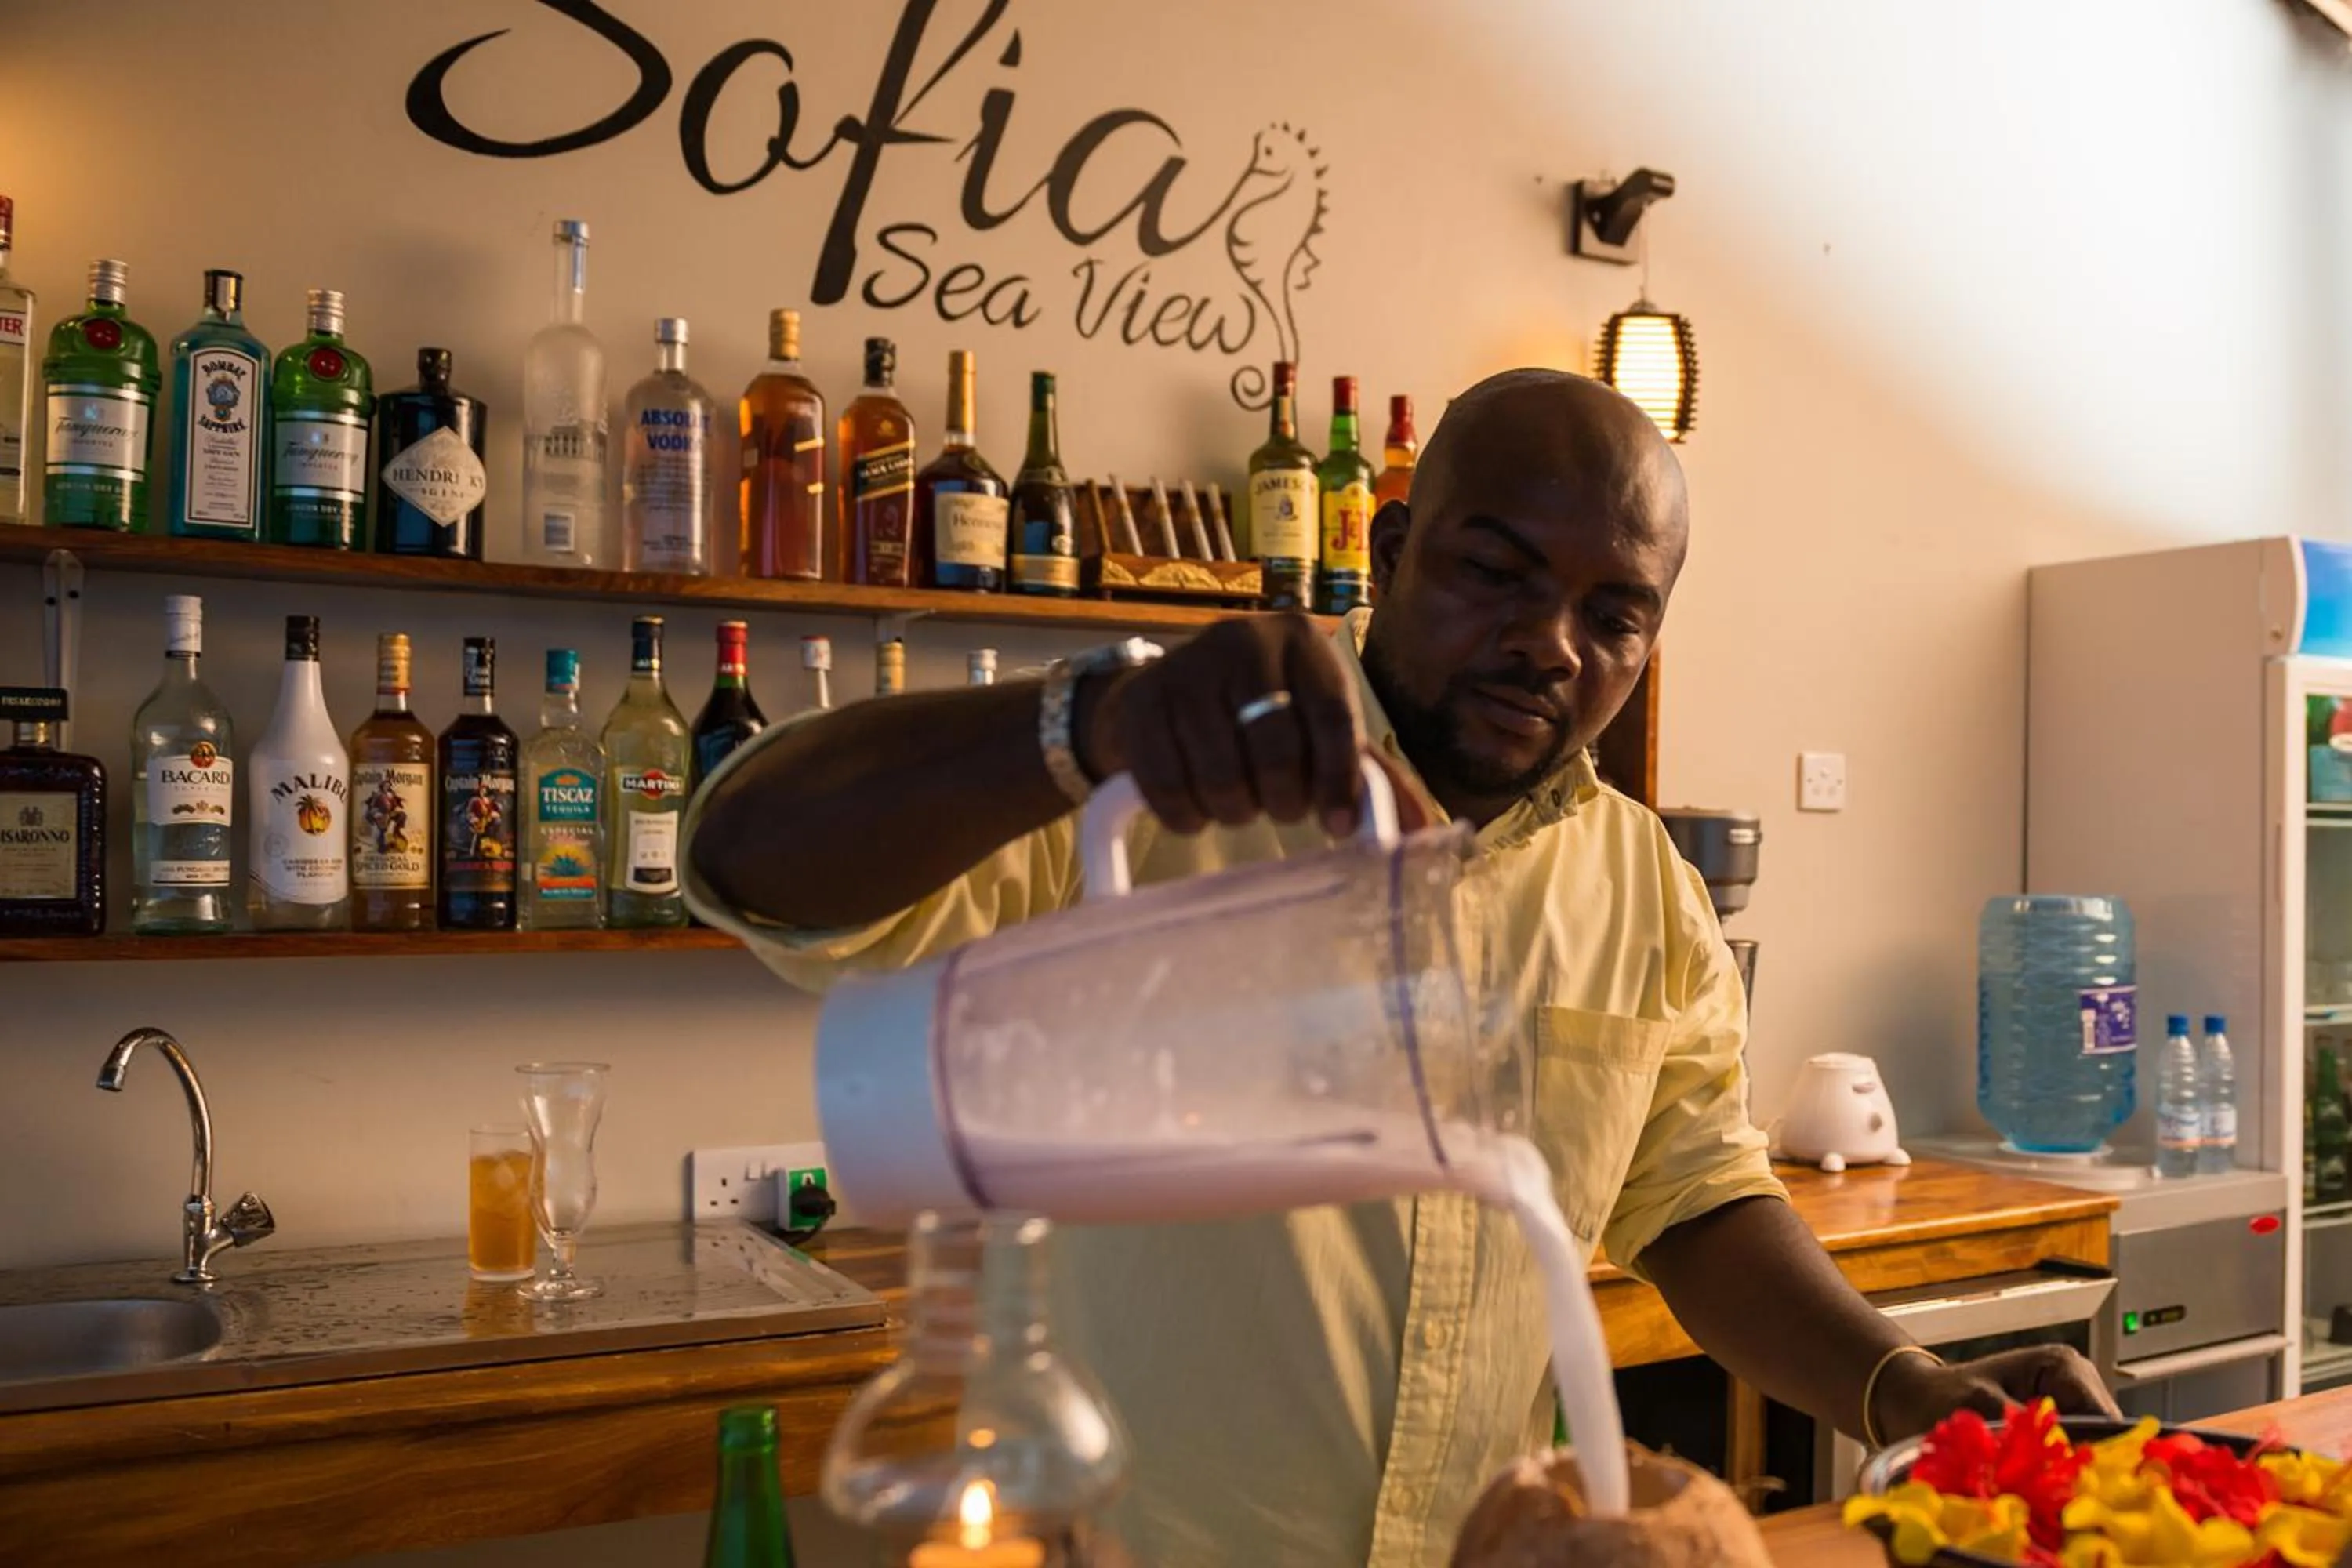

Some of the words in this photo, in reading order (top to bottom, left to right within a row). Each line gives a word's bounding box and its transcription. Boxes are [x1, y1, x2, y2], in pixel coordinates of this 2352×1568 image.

[862, 223, 1041, 328] Sea
[1073, 256, 1257, 354] View
[201, 360, 248, 381] BOMBAY
[198, 413, 249, 434] SAPPHIRE
[641, 408, 710, 432] ABSOLT
[270, 773, 348, 804] MALIBU
[625, 778, 680, 791] MARTINI
[540, 787, 594, 804] TISCAZ
[546, 805, 590, 814] TEQUILA
[540, 826, 595, 836] ESPECIAL
[390, 862, 420, 872] GOLD
